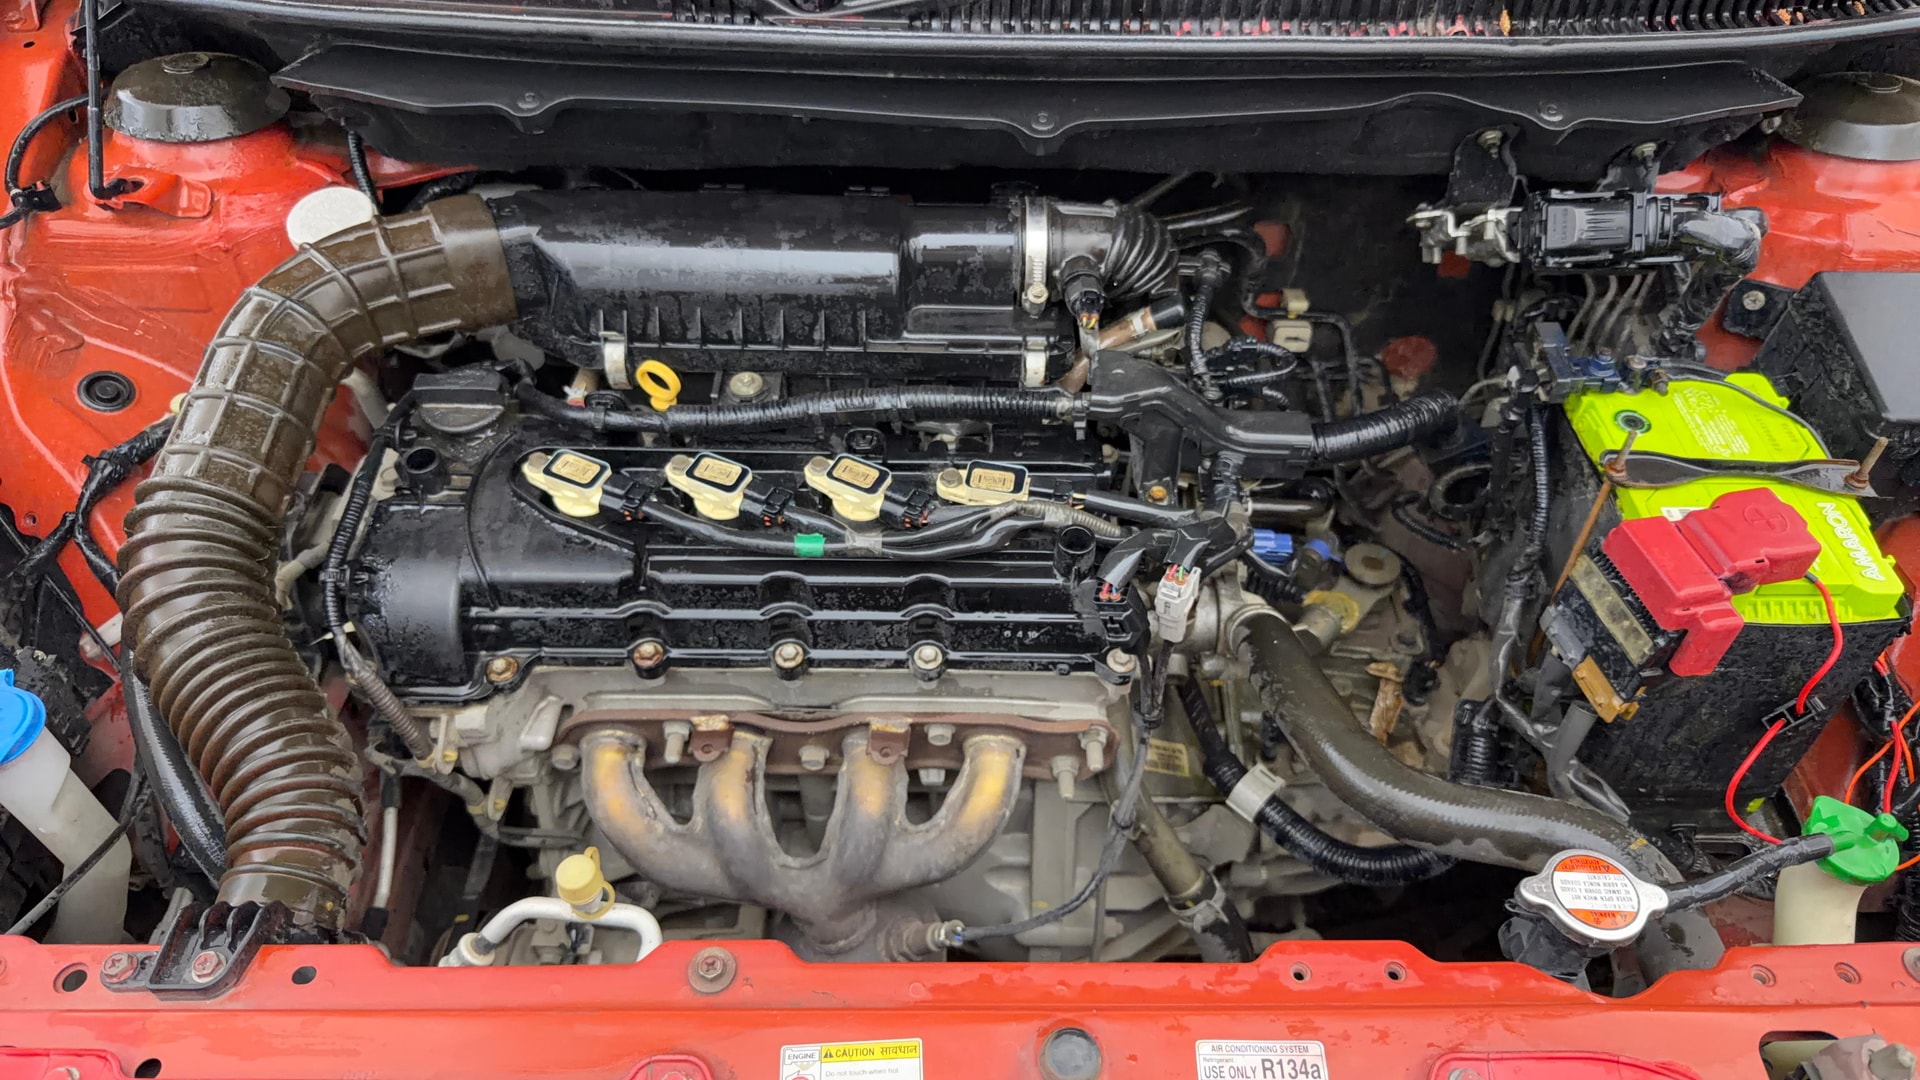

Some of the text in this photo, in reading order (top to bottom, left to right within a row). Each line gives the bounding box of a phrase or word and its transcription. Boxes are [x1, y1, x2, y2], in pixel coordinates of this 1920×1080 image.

[1816, 502, 1885, 582] AMARON
[835, 1048, 875, 1058] CAUTION
[880, 1045, 917, 1055] सावधान
[1225, 1045, 1278, 1053] CONDITIONING
[1280, 1045, 1309, 1053] SYSTEM
[787, 1052, 816, 1060] ENGINE
[1204, 1066, 1256, 1079] USE ONLY
[1261, 1058, 1322, 1080] R134a
